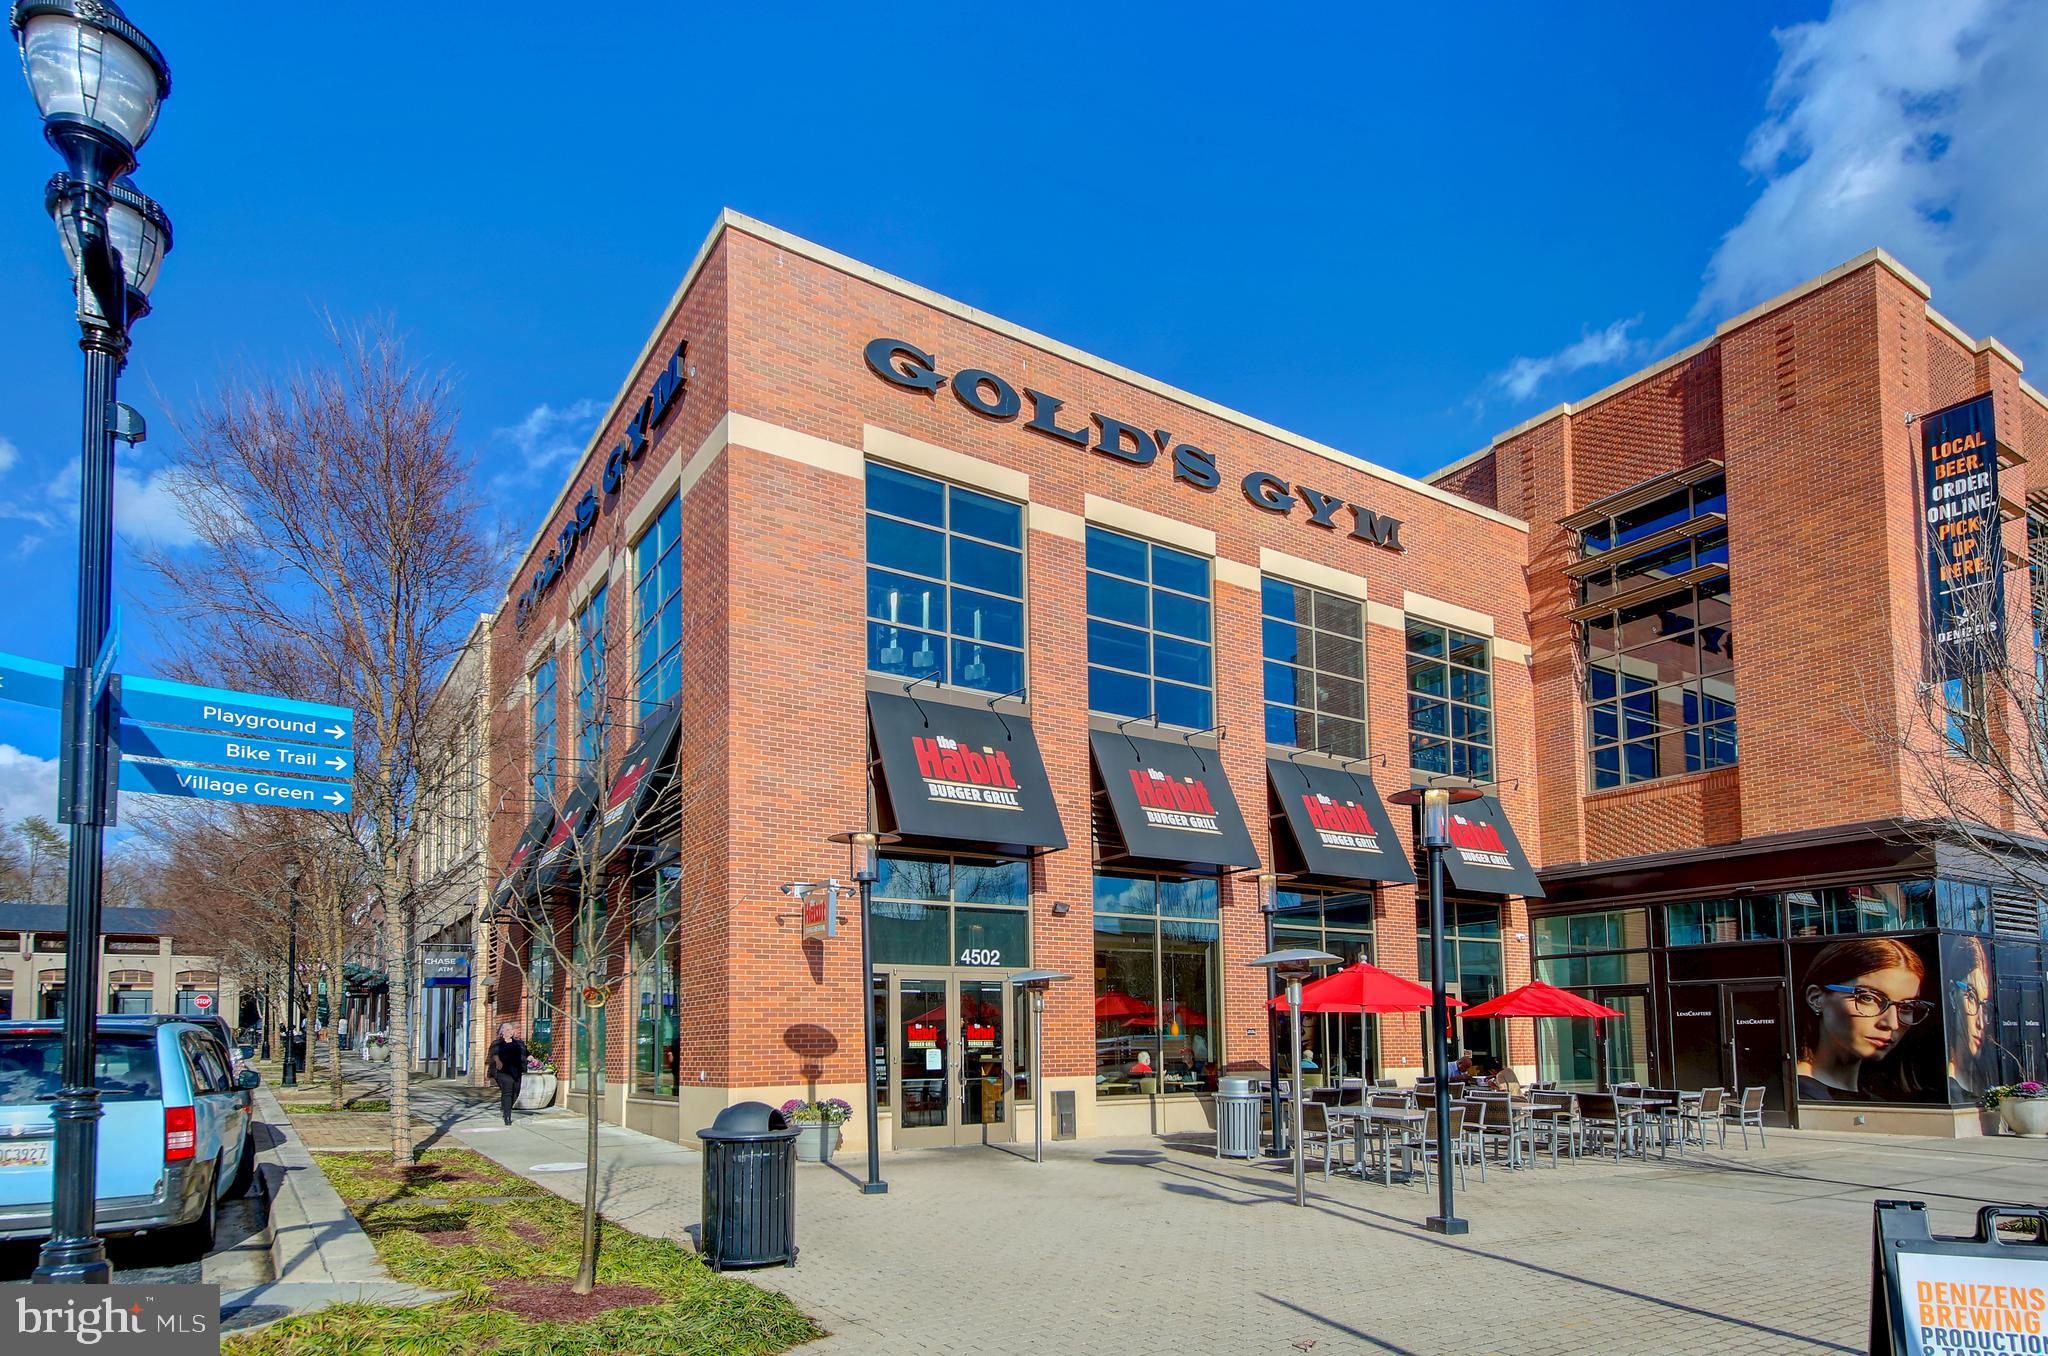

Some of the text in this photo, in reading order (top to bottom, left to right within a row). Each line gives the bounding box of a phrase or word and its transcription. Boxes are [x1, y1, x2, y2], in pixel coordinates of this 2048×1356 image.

[603, 340, 688, 494] GYM
[863, 338, 1406, 553] GOLD'S GYM
[1932, 432, 1986, 461] LOCAL
[1936, 455, 1984, 480] BEER.
[1932, 472, 1989, 501] ORDER
[1928, 492, 1996, 522] ONLINE.
[1953, 539, 1976, 557] UP
[203, 706, 316, 734] Playground
[227, 744, 317, 766] Bike Trail
[936, 736, 957, 750] the
[912, 736, 1017, 789] Habit
[1147, 768, 1165, 780] the
[176, 774, 315, 801] Village Green
[929, 784, 1019, 806] BURGER GRILL
[1129, 769, 1215, 815] Habit
[1146, 811, 1218, 830] BURGER GRILL
[1302, 794, 1376, 835] Habit
[1320, 833, 1380, 849] BURGER GRILL
[424, 957, 457, 965] CHASE
[960, 949, 1001, 965] 4502
[1917, 1280, 2046, 1311] DENIZENS
[1919, 1303, 2041, 1333] BREWING
